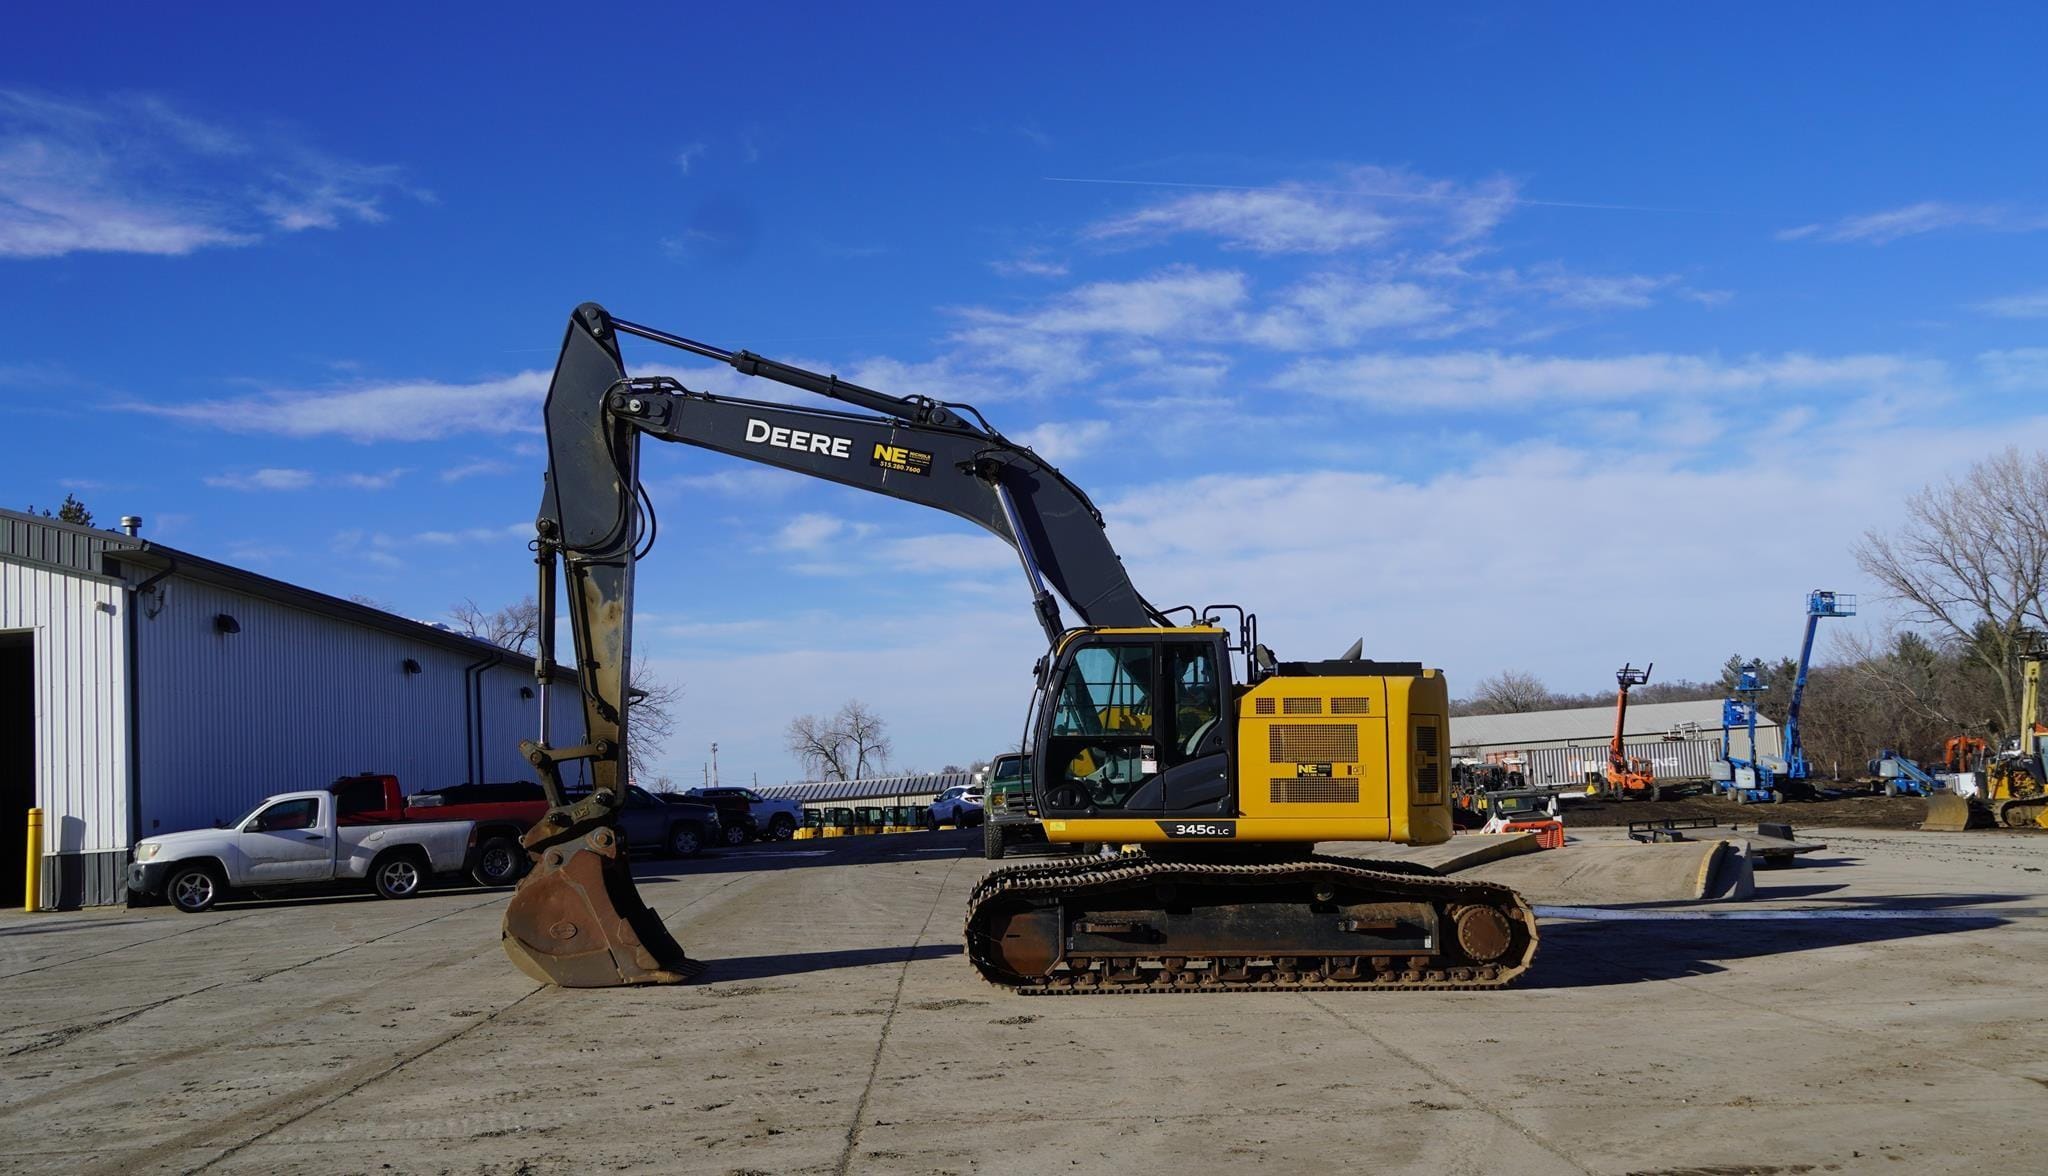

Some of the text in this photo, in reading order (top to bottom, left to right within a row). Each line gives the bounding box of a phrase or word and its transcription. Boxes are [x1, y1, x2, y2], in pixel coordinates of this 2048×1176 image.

[745, 419, 852, 459] DEERE
[873, 444, 908, 464] NE
[1298, 764, 1318, 774] NE
[1176, 824, 1216, 835] 345G
